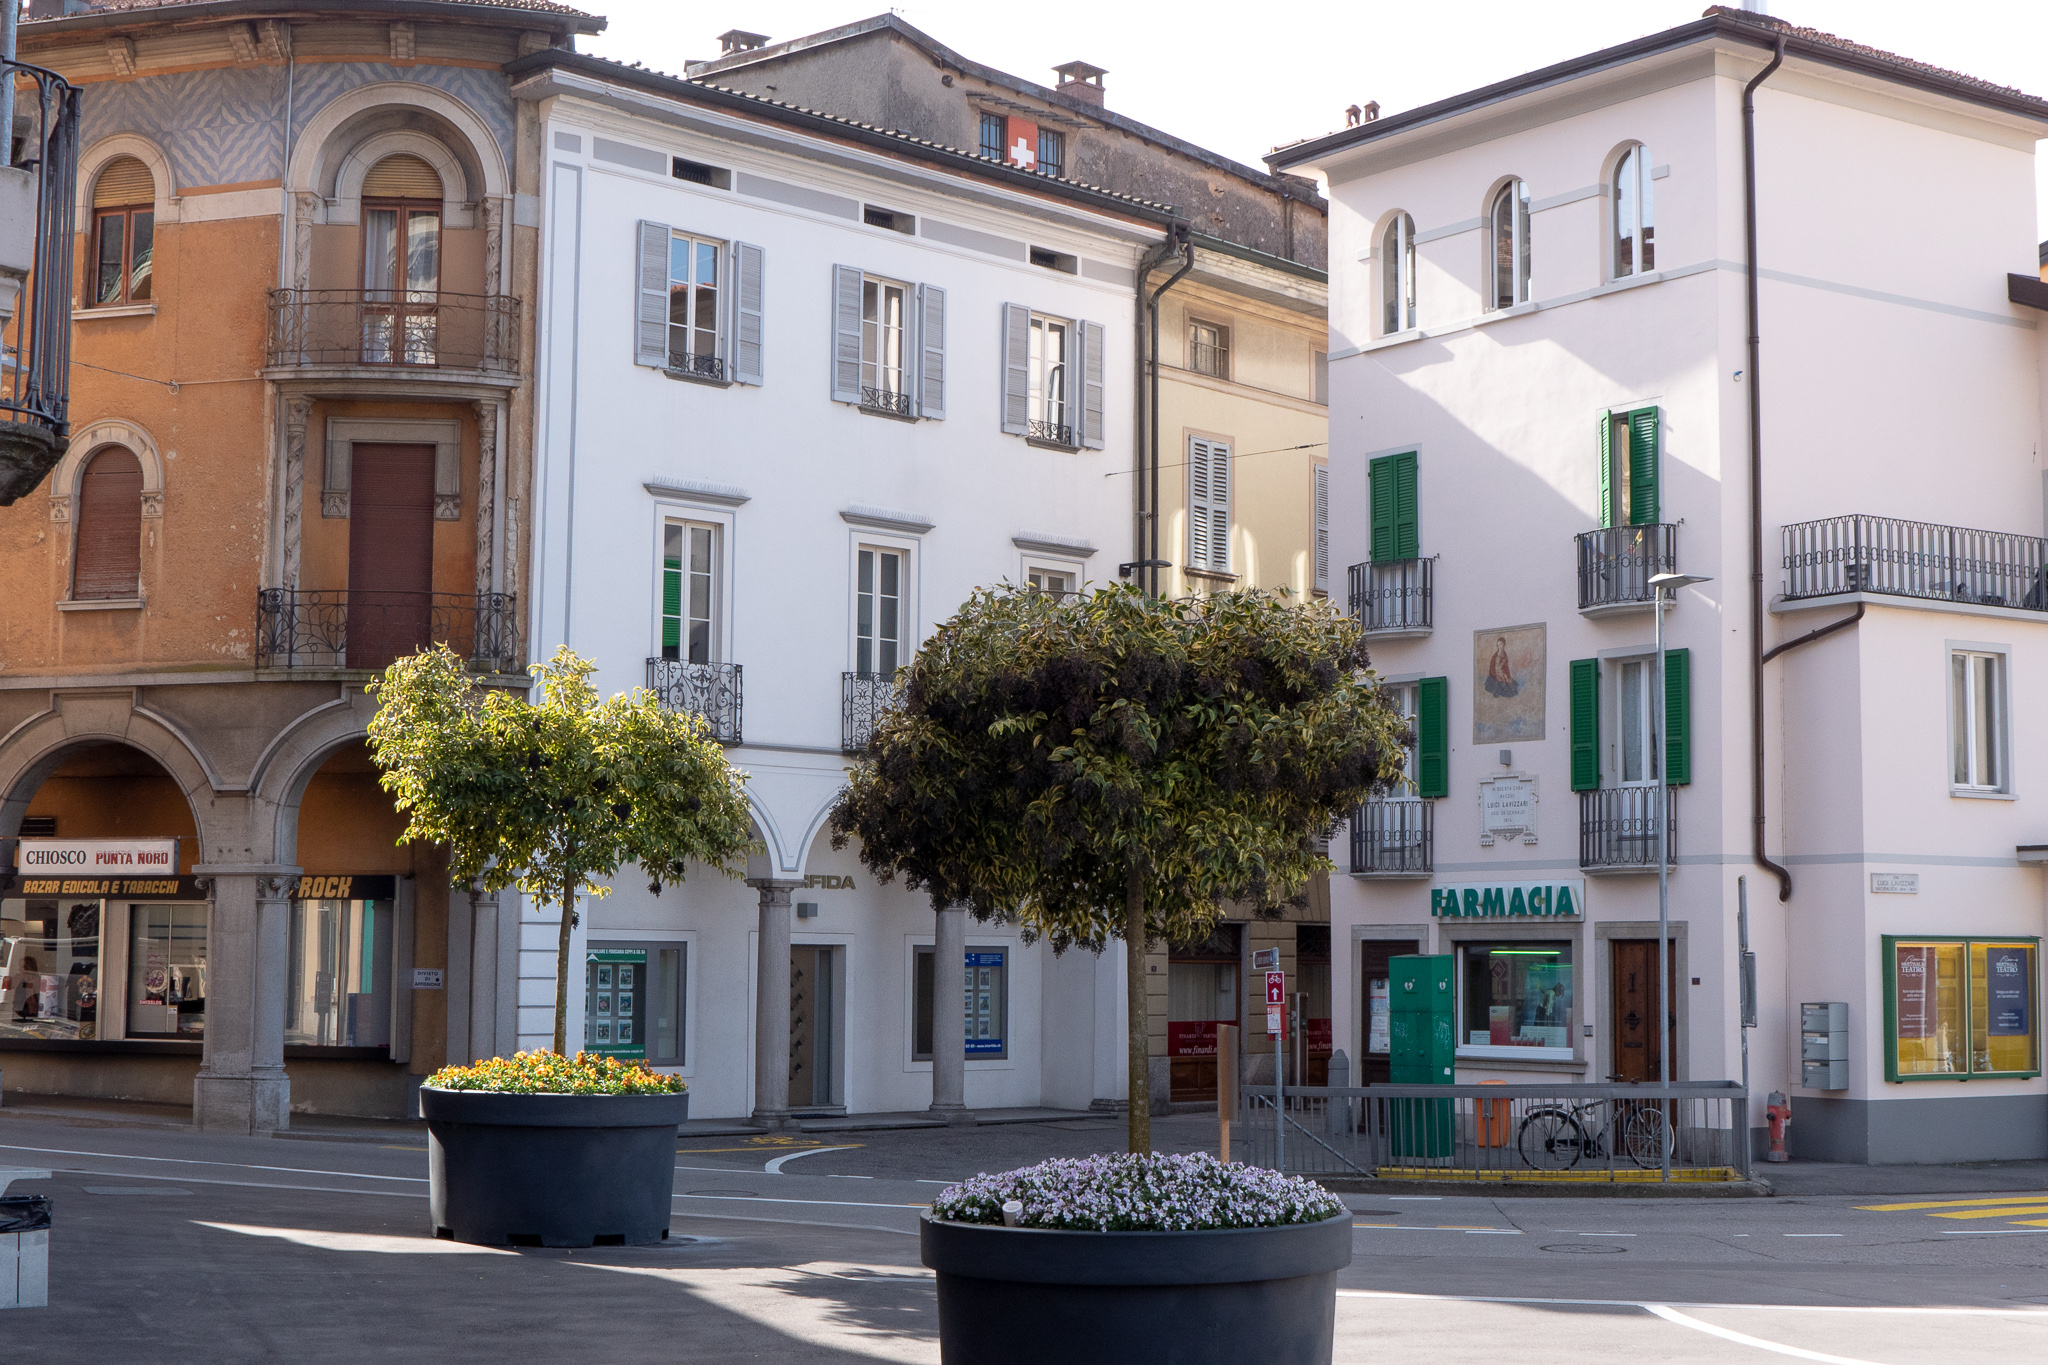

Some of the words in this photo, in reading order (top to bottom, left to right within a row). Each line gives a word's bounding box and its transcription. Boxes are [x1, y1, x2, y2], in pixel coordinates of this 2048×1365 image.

[26, 850, 87, 864] CHIOSCO
[95, 852, 133, 865] PUNTA
[137, 852, 169, 865] NORD
[23, 881, 60, 894] BAZAR
[62, 881, 109, 894] EDICOLA
[111, 881, 120, 893] E
[122, 881, 179, 894] TABACCHI
[298, 877, 353, 898] ROCK
[1431, 886, 1577, 917] FARMACIA
